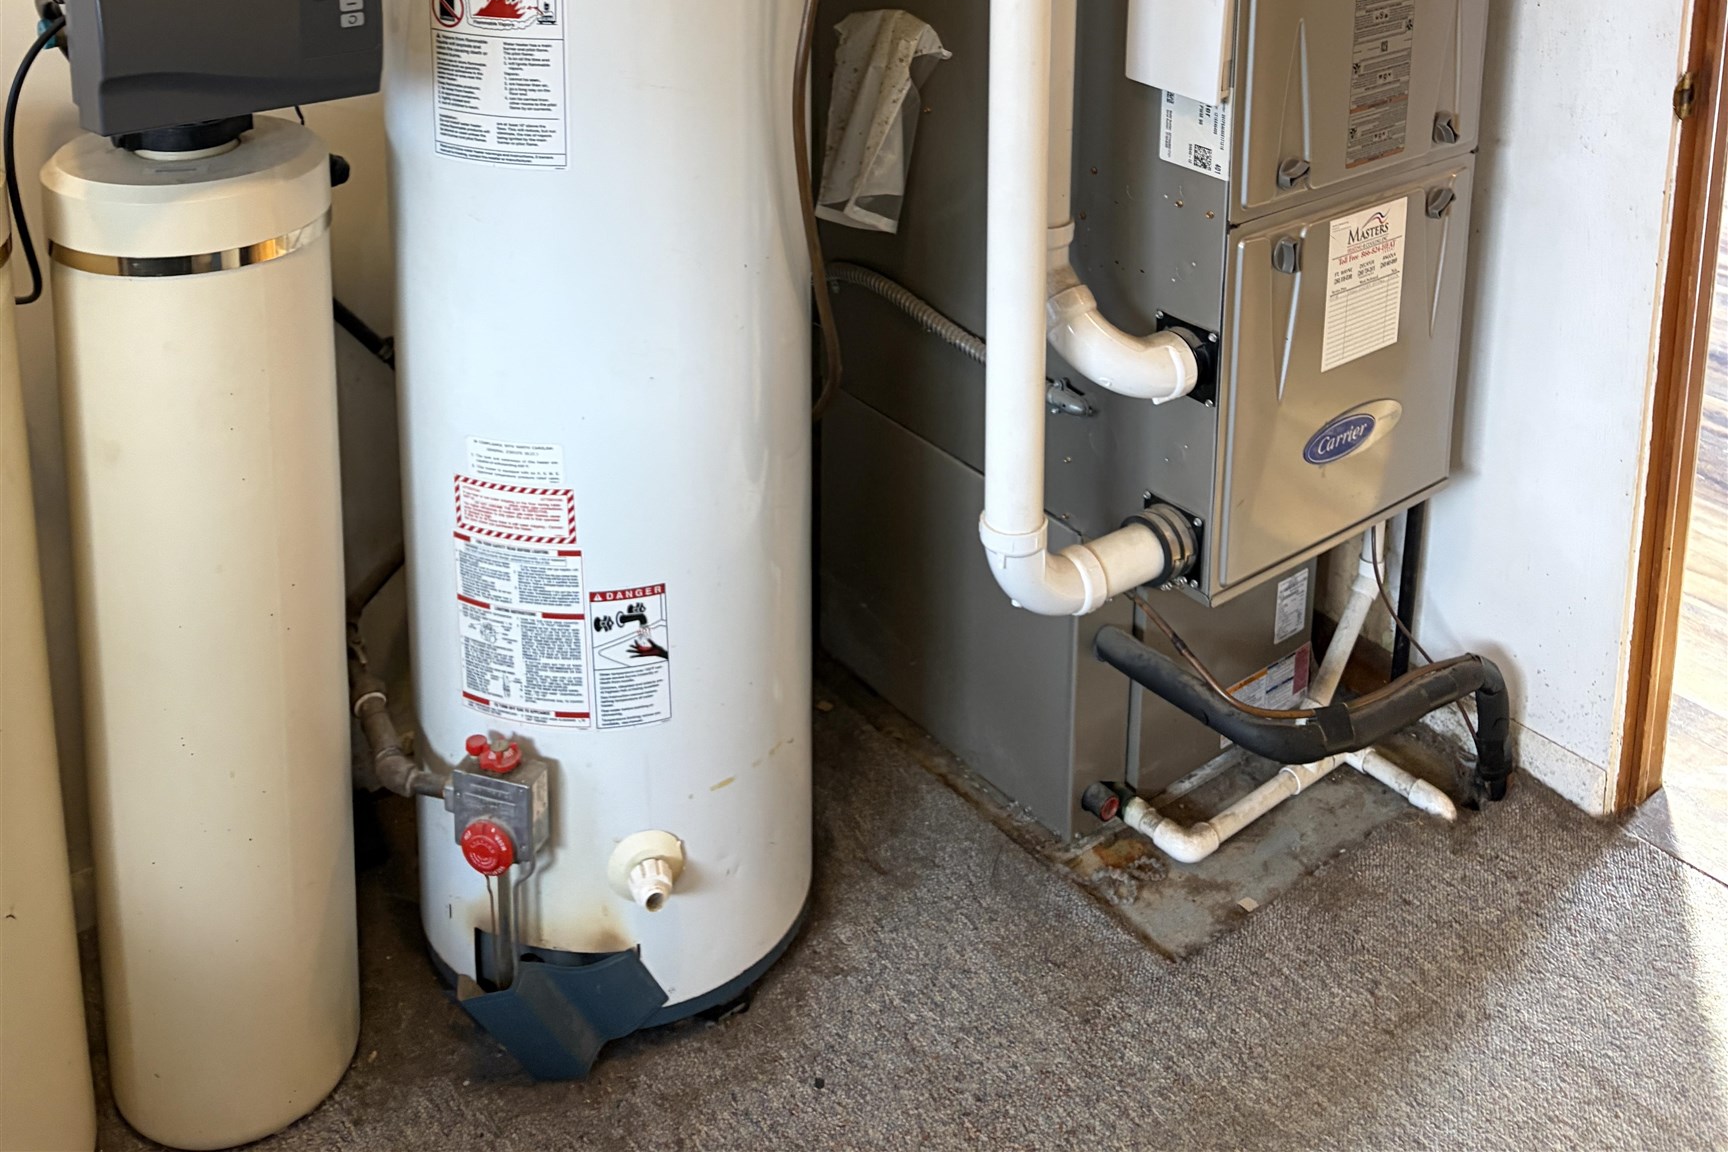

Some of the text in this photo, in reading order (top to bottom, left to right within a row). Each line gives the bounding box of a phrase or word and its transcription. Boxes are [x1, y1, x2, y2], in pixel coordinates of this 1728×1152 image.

[1348, 222, 1389, 245] MASTERS
[1317, 423, 1367, 454] Carrier
[606, 586, 662, 600] DANGER
